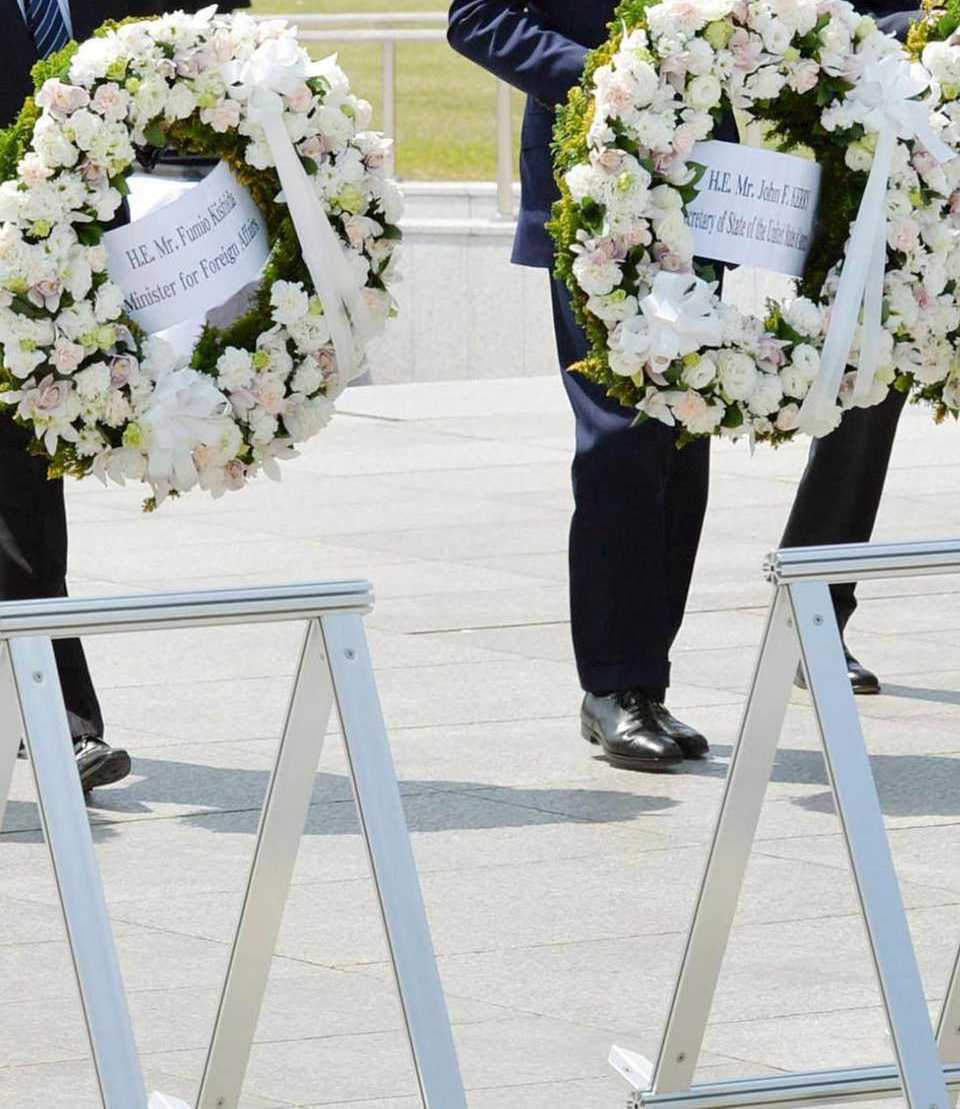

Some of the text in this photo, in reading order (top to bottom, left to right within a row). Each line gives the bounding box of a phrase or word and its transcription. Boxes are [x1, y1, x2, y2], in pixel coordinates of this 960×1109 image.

[708, 170, 732, 193] H.E.
[735, 174, 754, 198] Mr.
[758, 179, 780, 204] John
[123, 216, 260, 314] Minister for Foreign Affairs
[125, 246, 156, 270] H.E.
[153, 236, 180, 259] Mr.
[176, 215, 211, 247] Fumio
